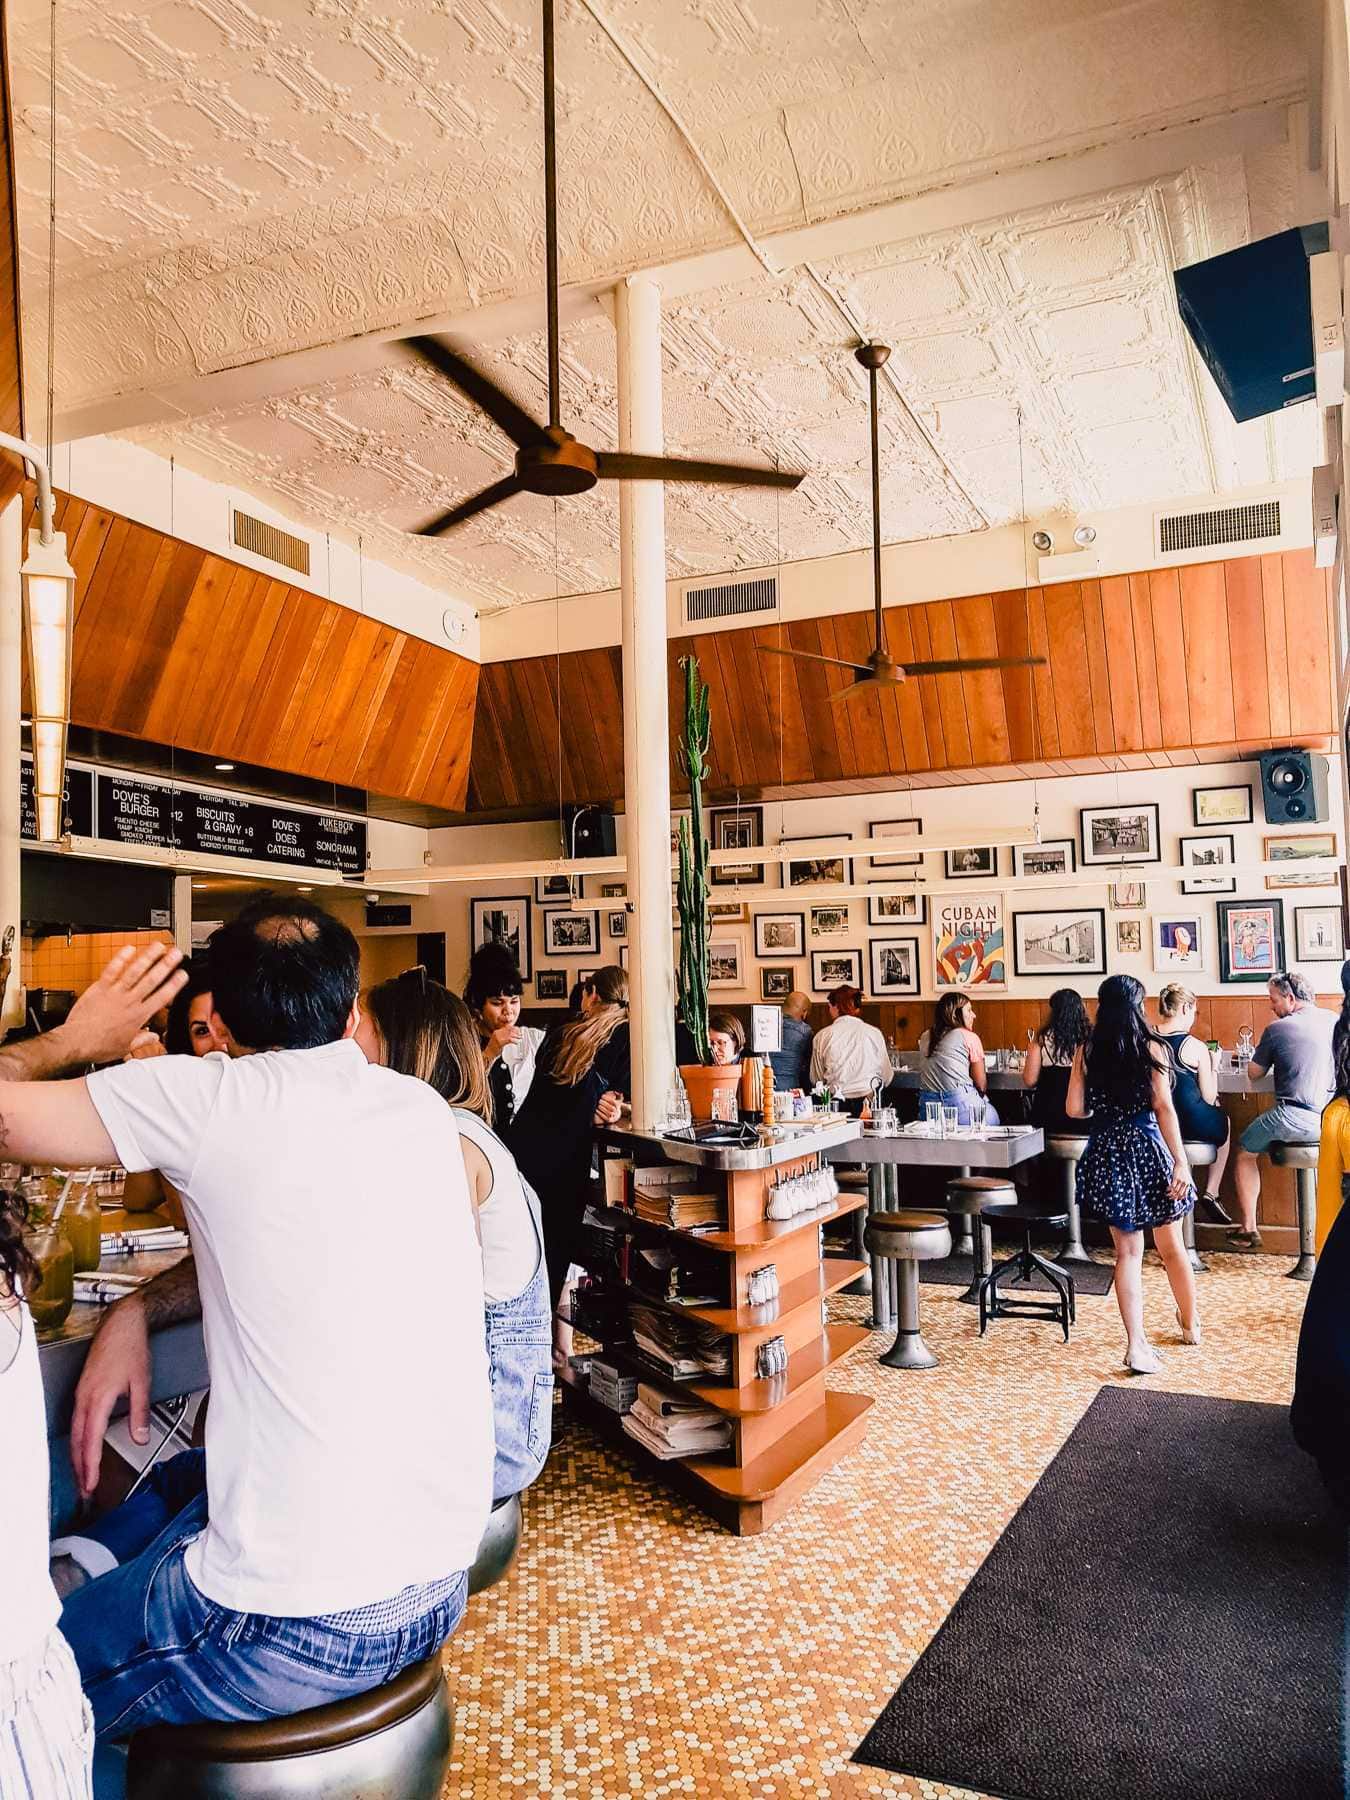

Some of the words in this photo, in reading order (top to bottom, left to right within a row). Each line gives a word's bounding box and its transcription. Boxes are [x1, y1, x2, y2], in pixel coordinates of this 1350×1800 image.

[112, 789, 150, 806] DOVE'S
[120, 802, 159, 818] BURGER
[170, 810, 183, 822] $12
[196, 807, 235, 822] BISCUITS
[204, 820, 210, 830] &
[212, 821, 242, 834] GRAVY
[244, 826, 254, 837] $8
[272, 819, 300, 832] DOVE'S
[318, 817, 354, 832] JUKEBOX
[275, 832, 297, 844] DOES
[267, 844, 305, 858] CATERING
[316, 840, 357, 856] SONORAMA
[942, 906, 997, 920] CUBAN
[942, 921, 996, 936] NIGHT
